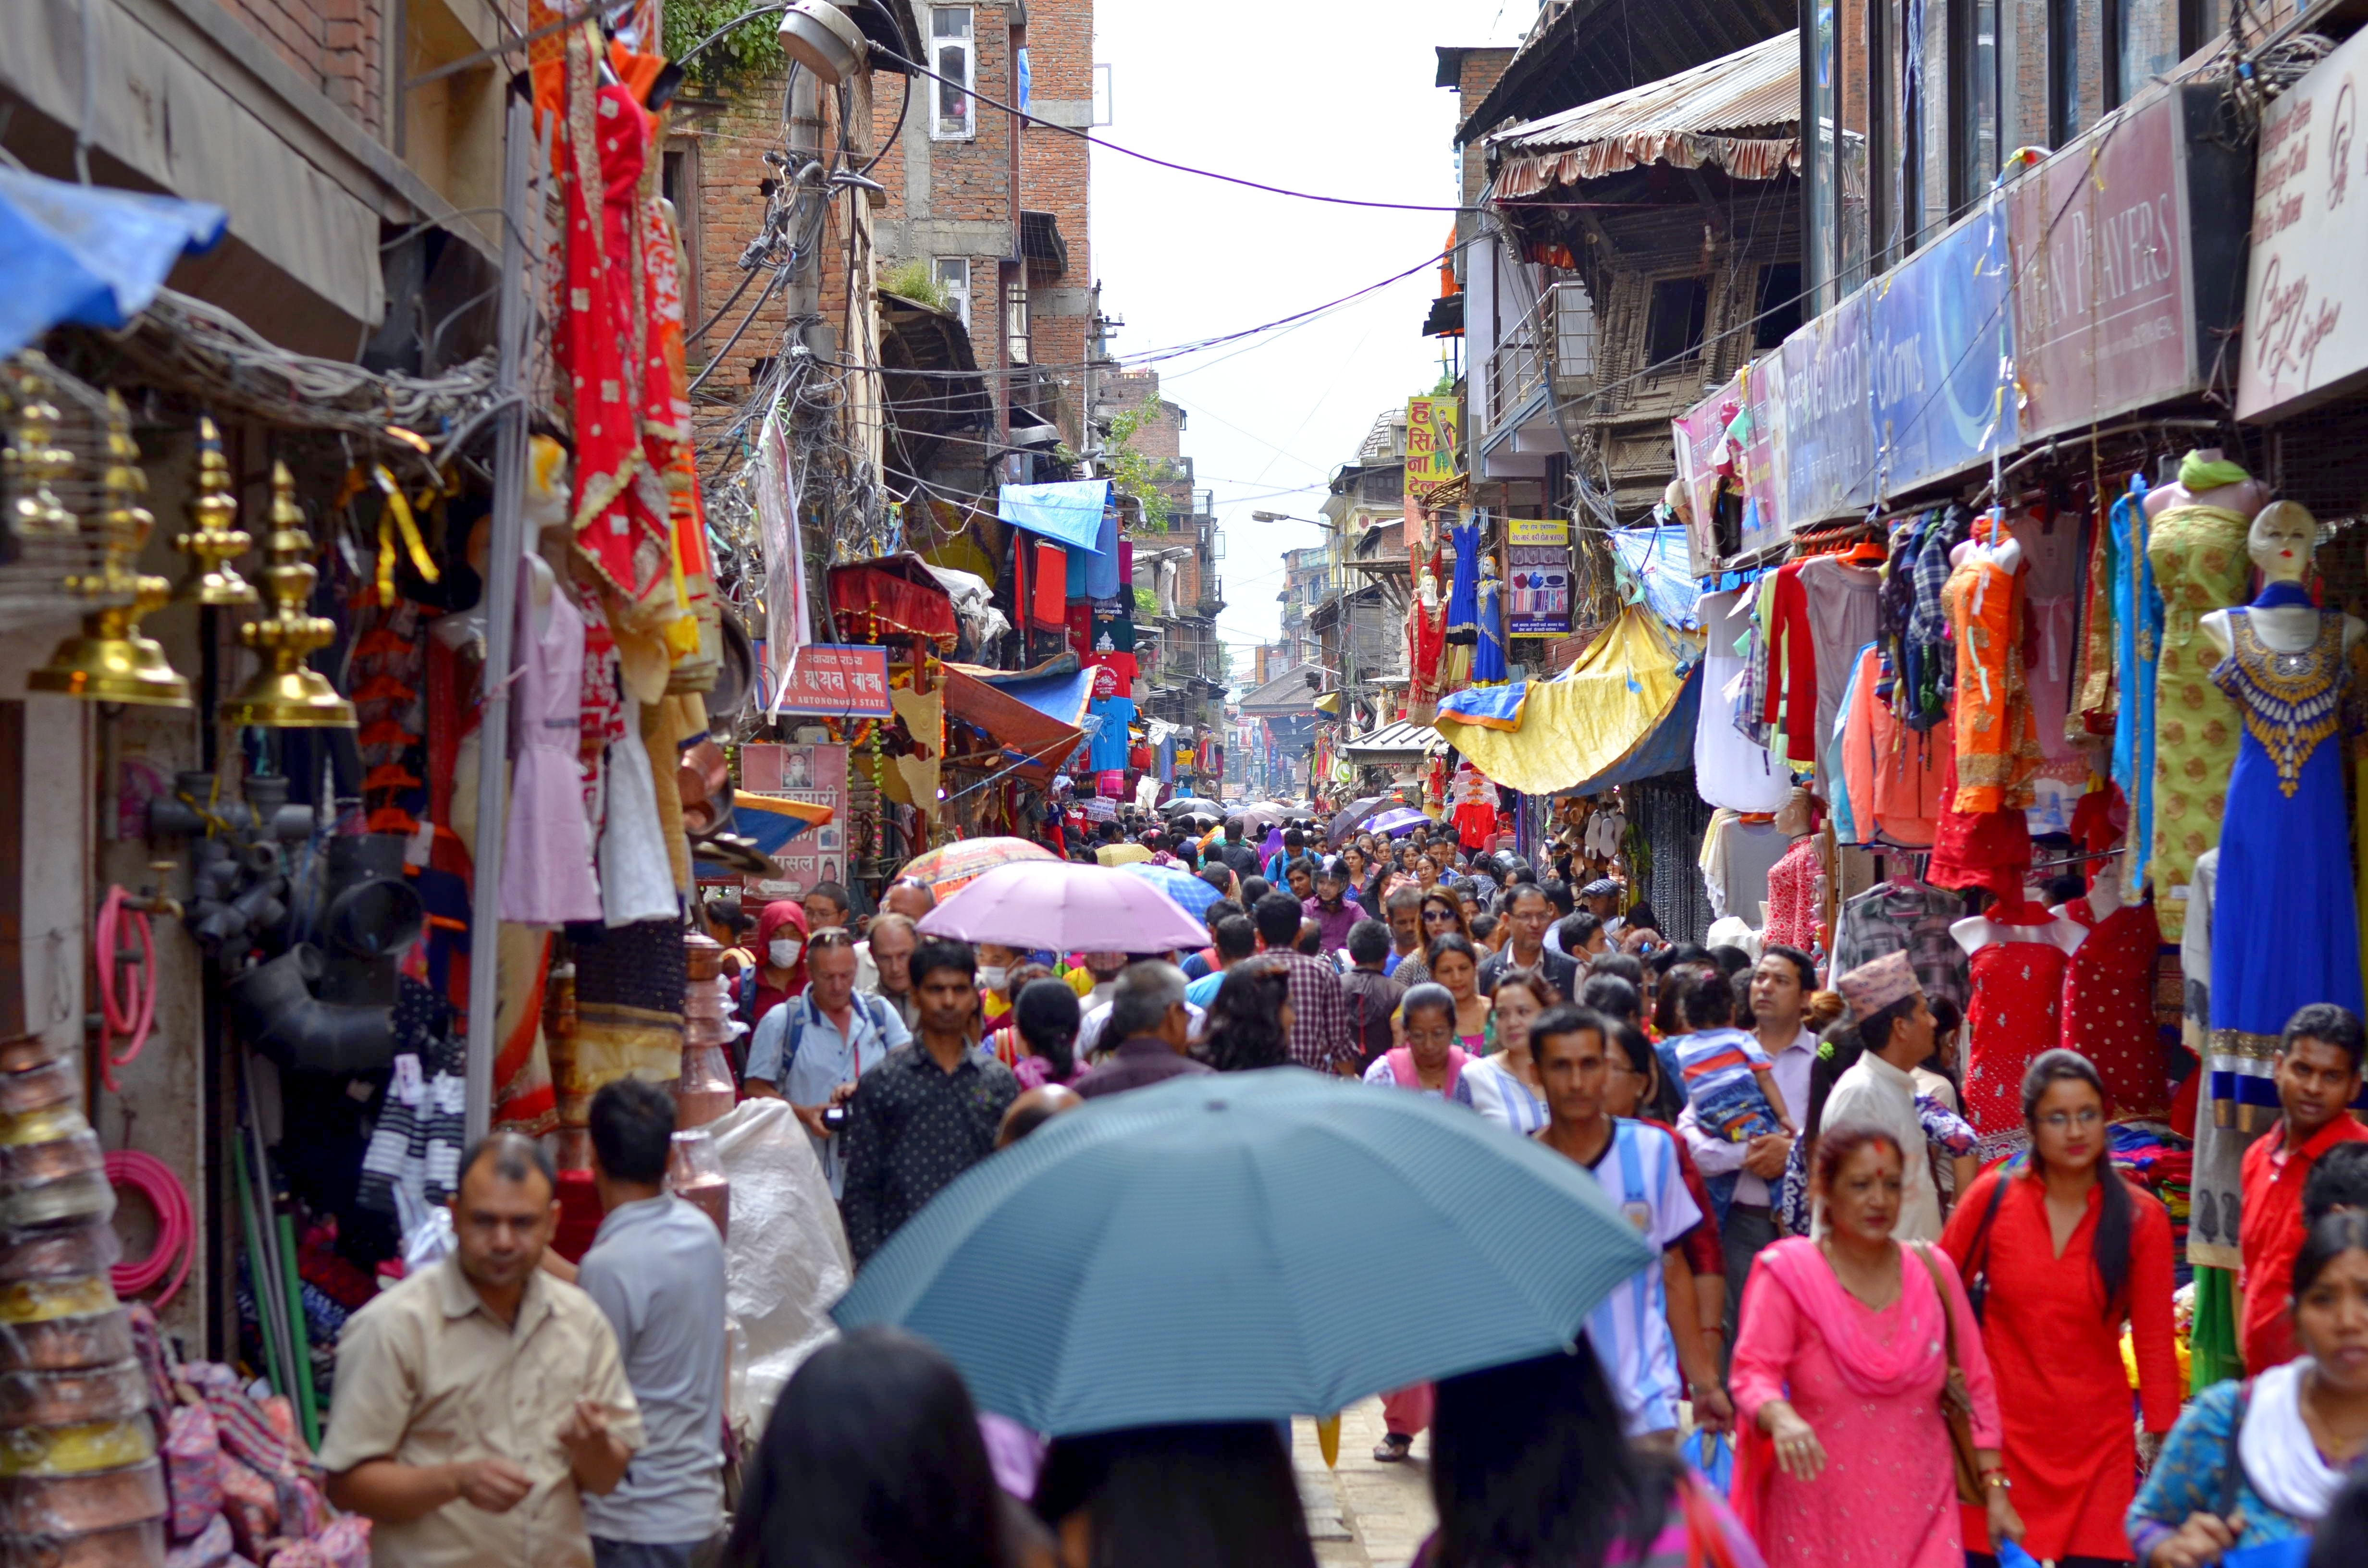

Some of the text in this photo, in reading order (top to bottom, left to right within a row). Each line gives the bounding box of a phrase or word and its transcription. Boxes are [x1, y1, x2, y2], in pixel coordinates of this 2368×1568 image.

[2072, 193, 2172, 315] PLAYERS
[798, 695, 856, 706] AUTONOMOUS
[860, 698, 885, 707] STATE
